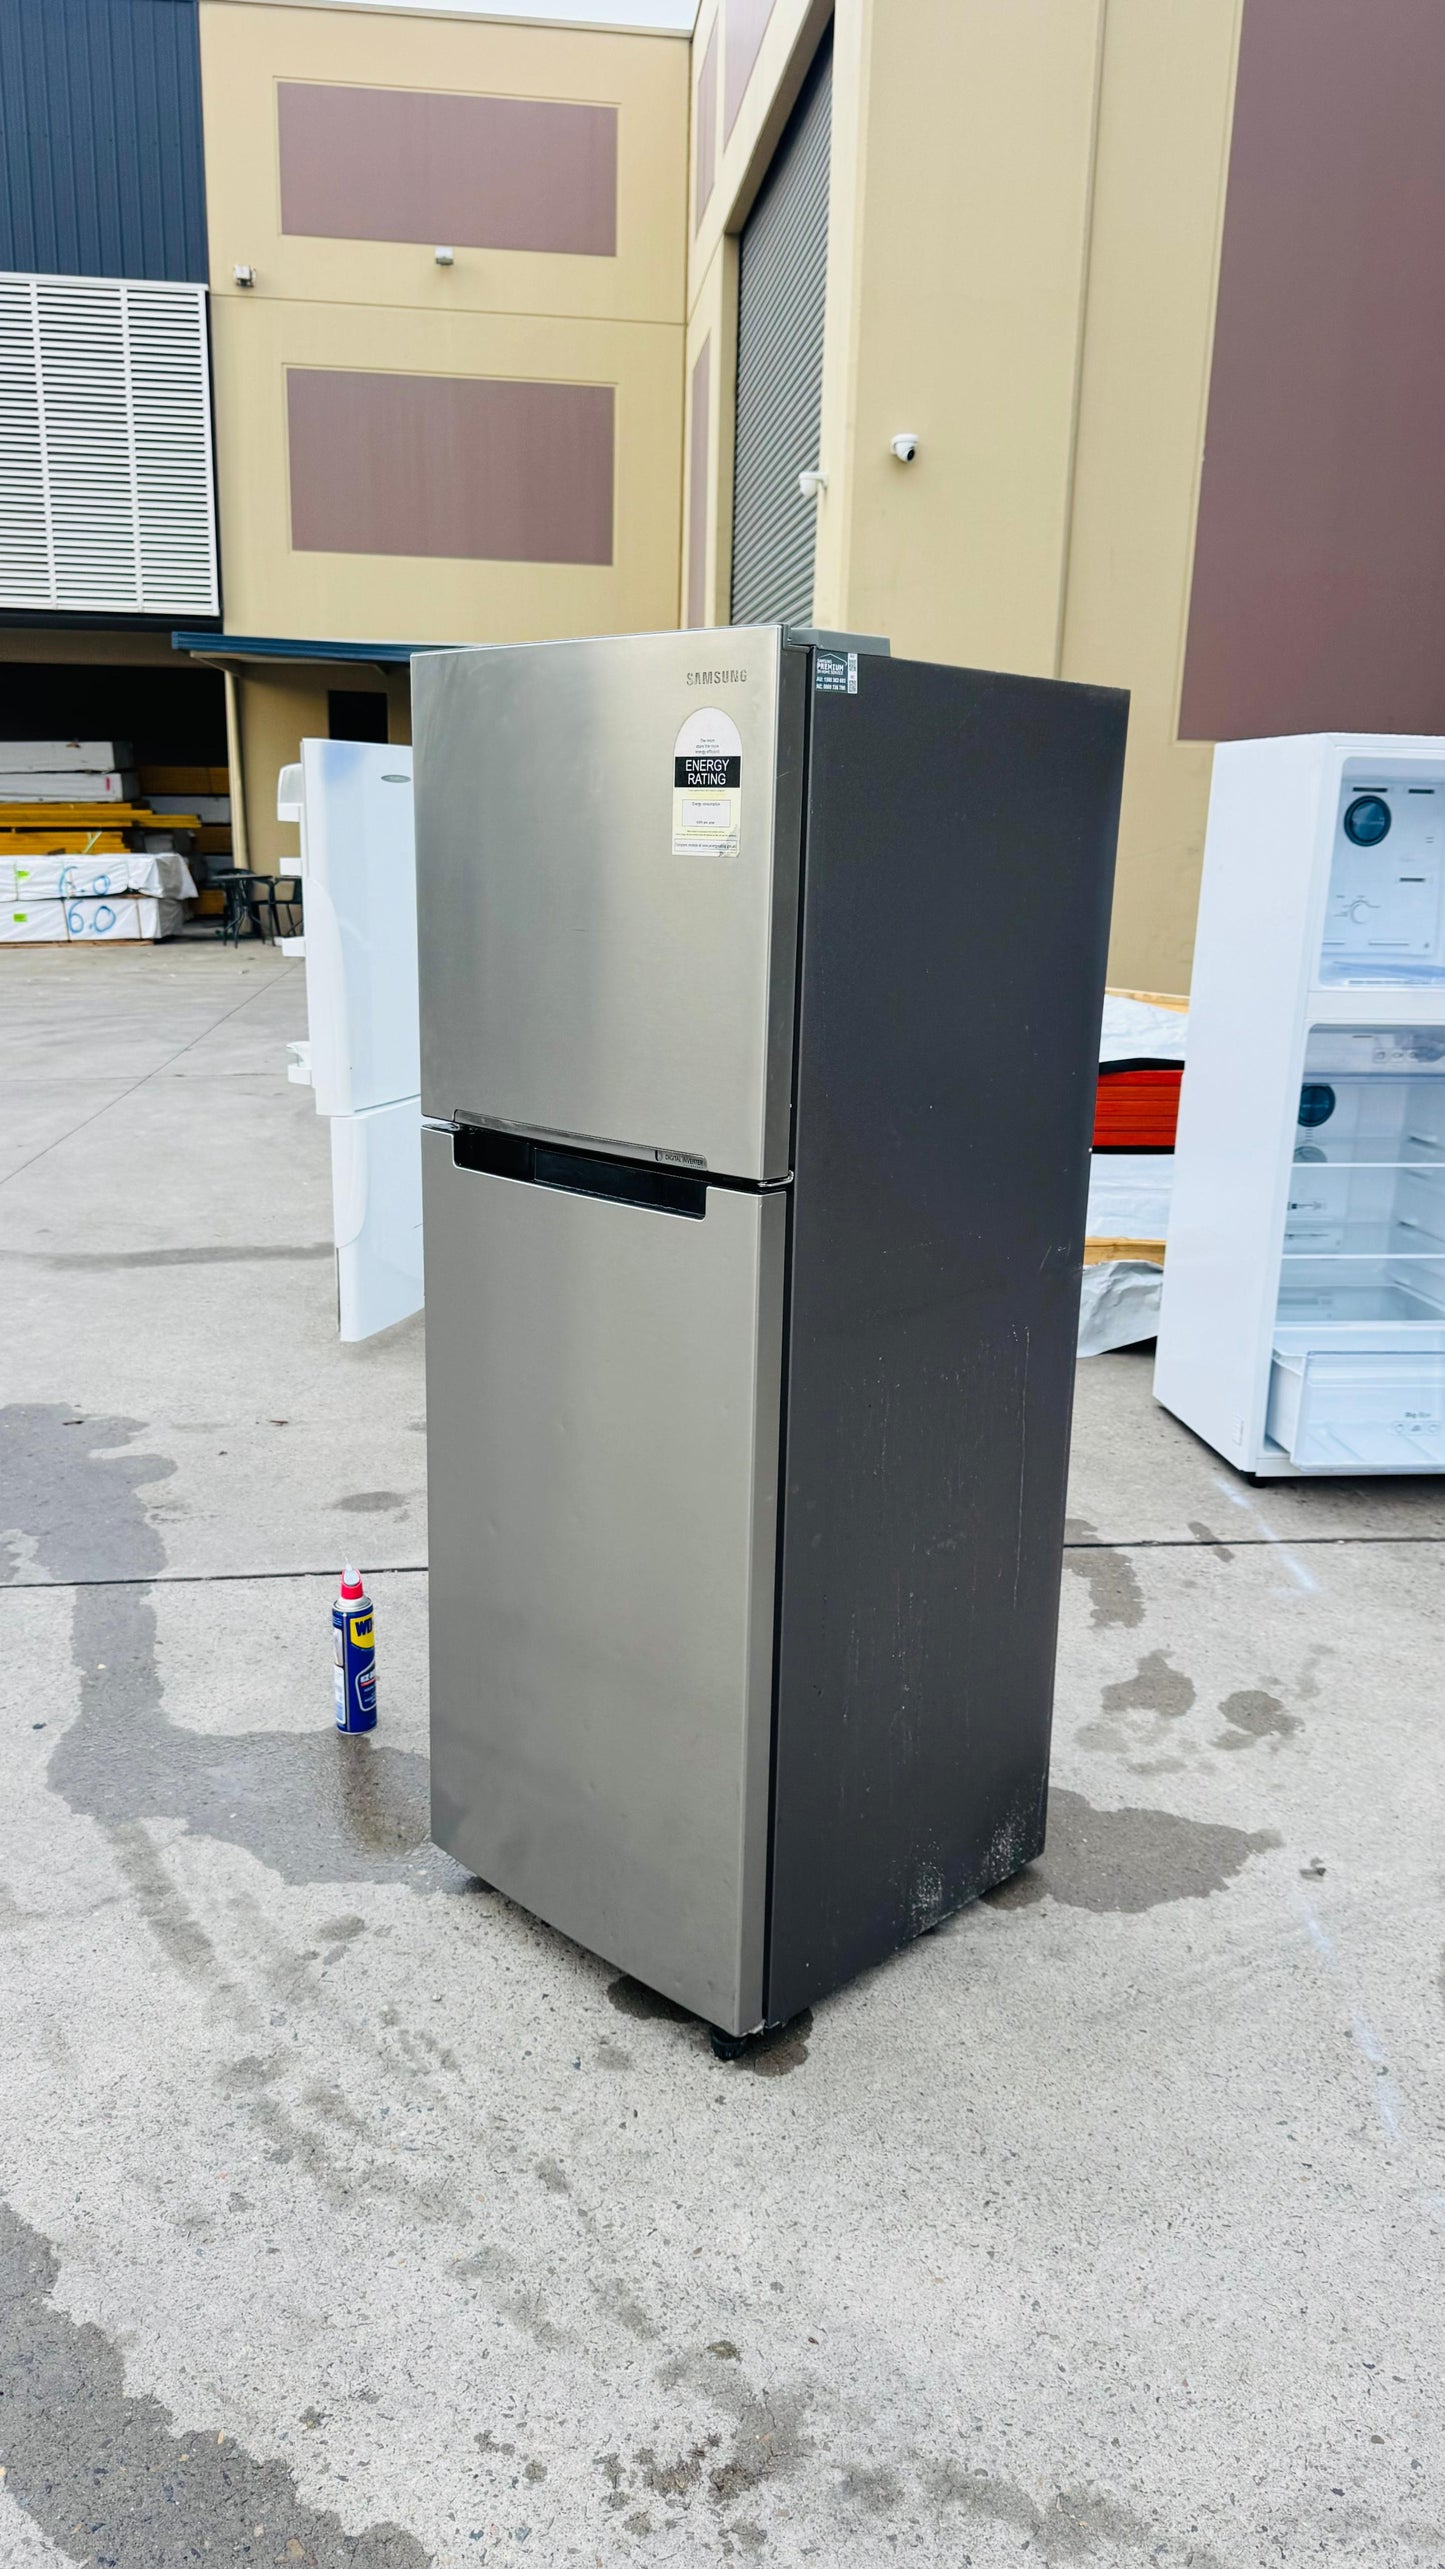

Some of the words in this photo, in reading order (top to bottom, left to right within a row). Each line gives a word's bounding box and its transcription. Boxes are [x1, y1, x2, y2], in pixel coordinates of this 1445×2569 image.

[686, 669, 747, 686] SAMSUNG
[685, 759, 730, 772] ENERGY
[687, 773, 726, 785] RATING
[68, 900, 117, 934] 6.0
[665, 1154, 681, 1162] DIGITAL
[683, 1156, 703, 1165] INVERTER
